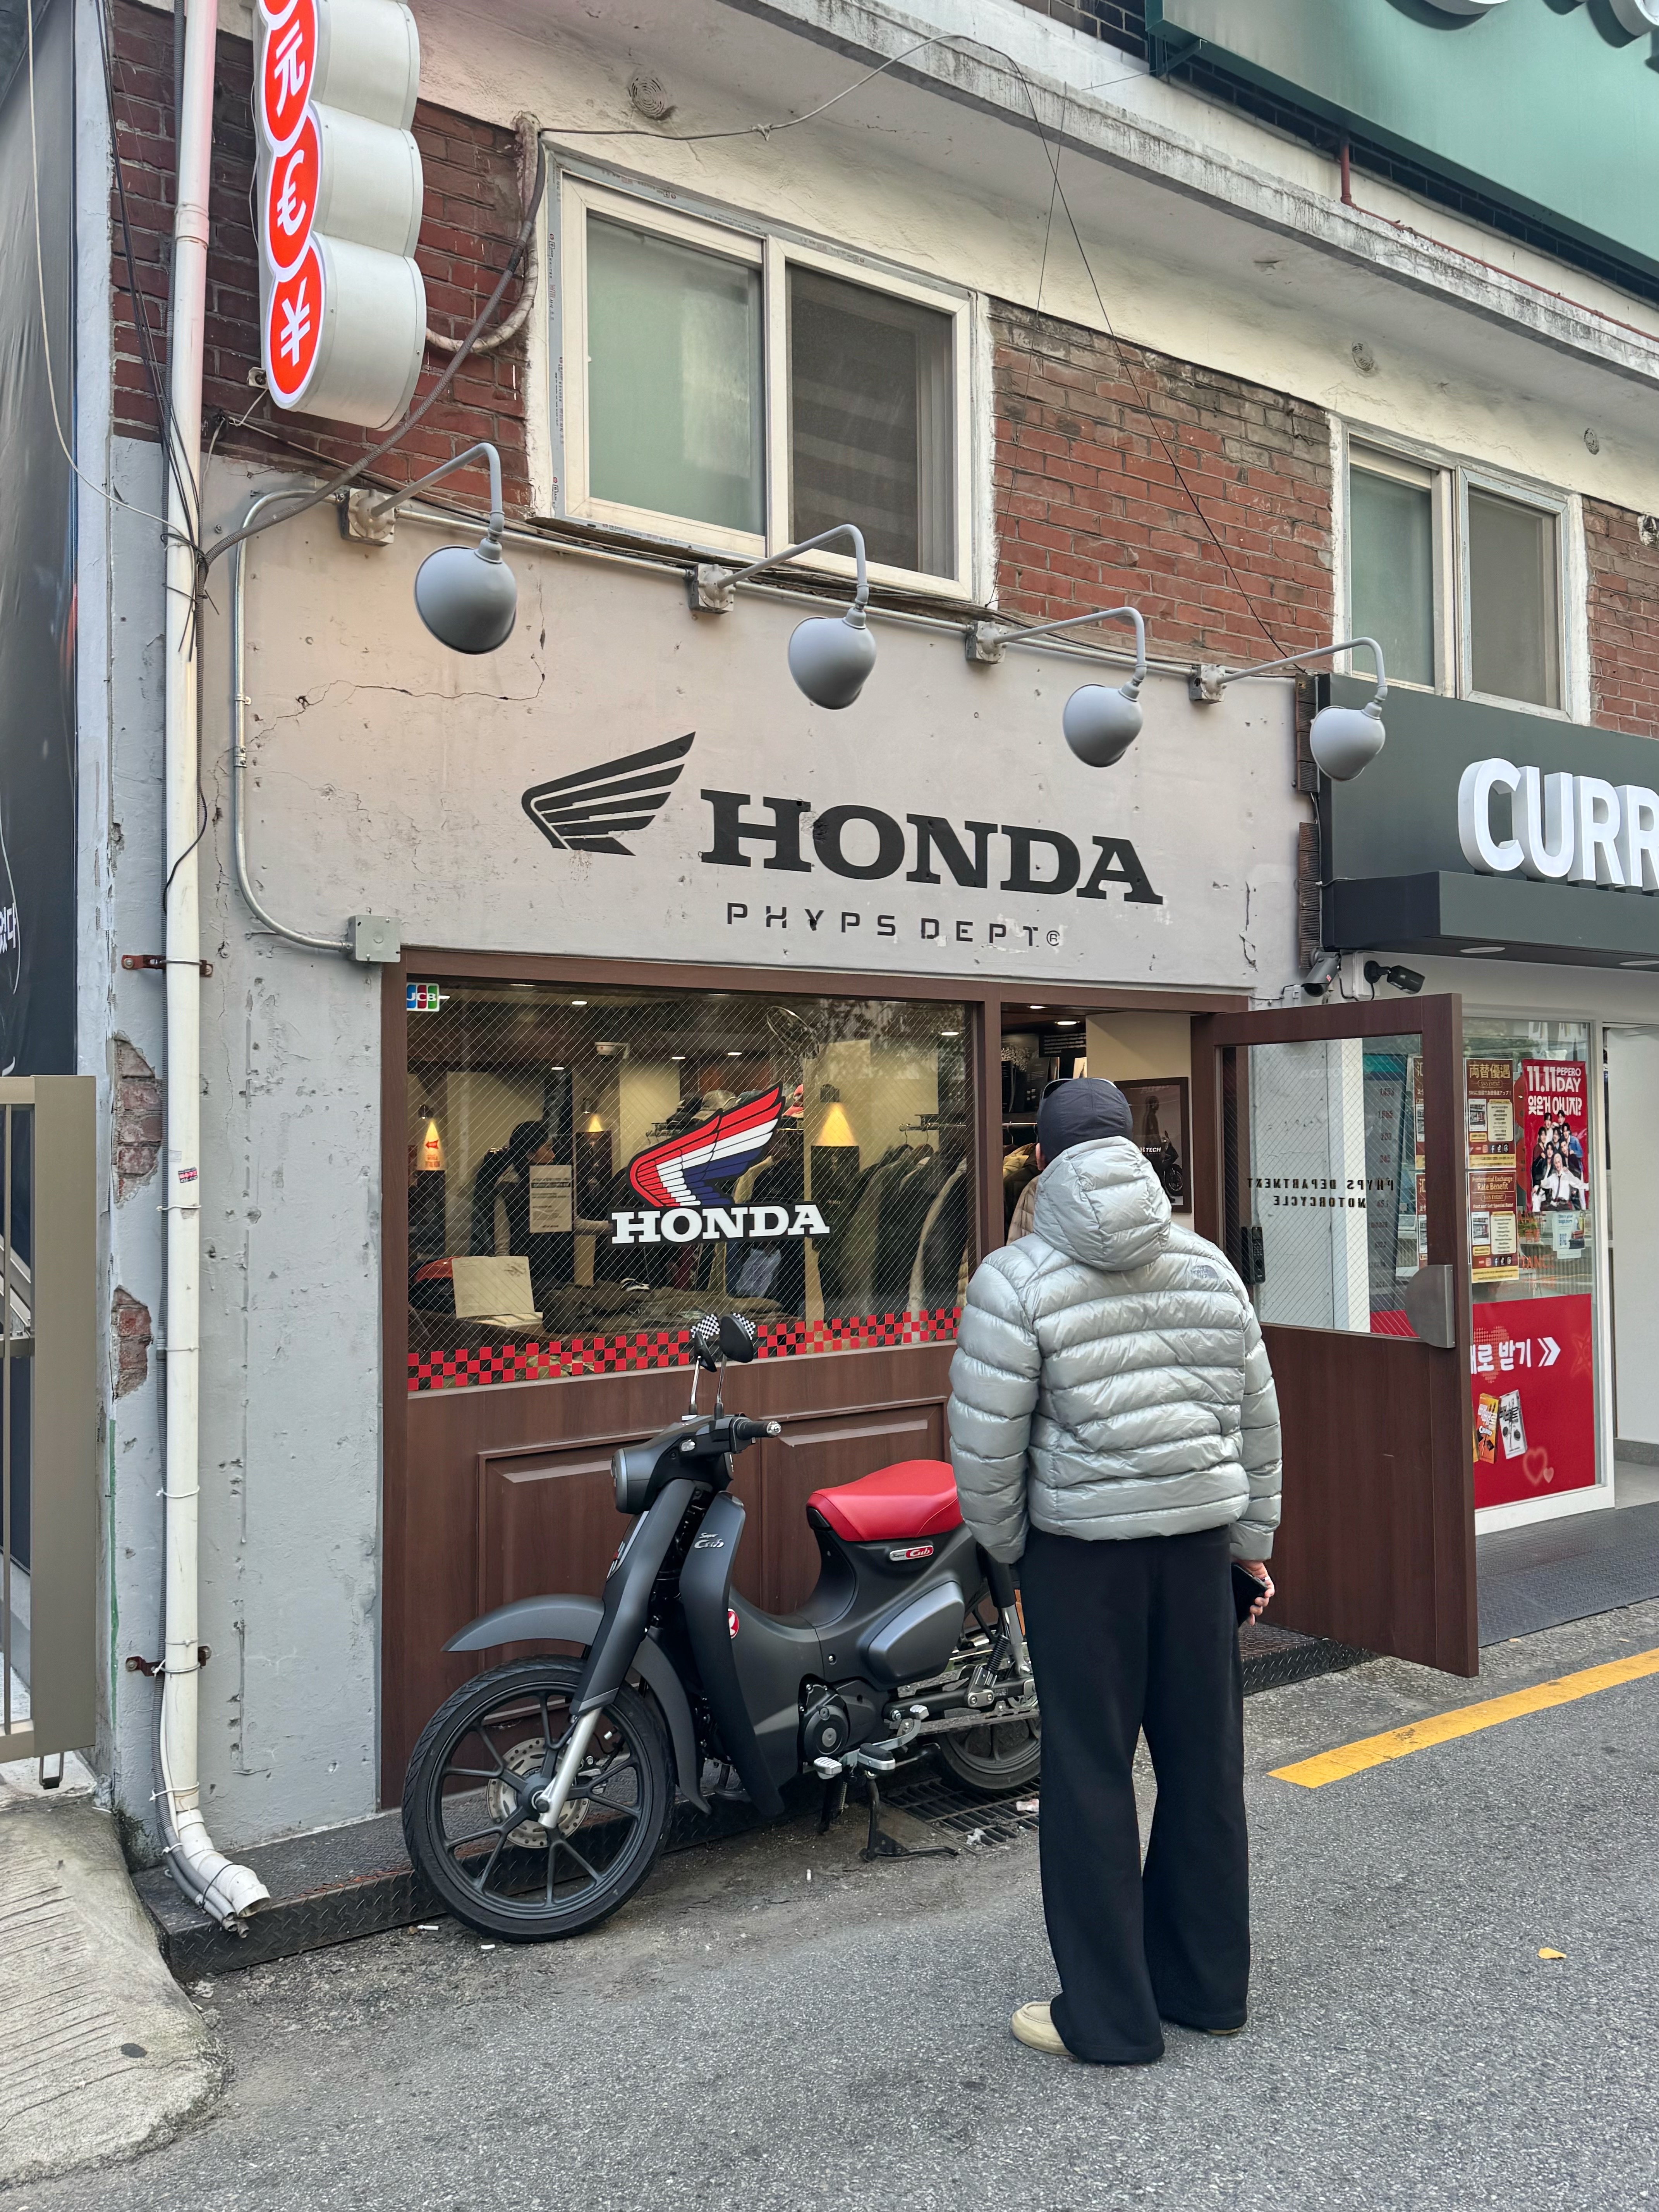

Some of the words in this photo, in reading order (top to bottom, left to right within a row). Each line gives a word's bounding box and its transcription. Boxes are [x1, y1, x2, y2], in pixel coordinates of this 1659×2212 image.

[699, 788, 1163, 905] HONDA
[727, 902, 895, 936] PHYPS
[406, 993, 436, 1001] JCB
[1469, 1063, 1511, 1079] 両替優遇
[1527, 1066, 1556, 1092] 11.11
[1556, 1067, 1581, 1077] PEPERO
[1557, 1077, 1581, 1093] DAY
[1552, 1096, 1582, 1116] 아니지?
[1490, 1182, 1508, 1190] Benefit
[611, 1204, 830, 1244] HONDA
[1498, 1338, 1531, 1371] 받기
[910, 1547, 930, 1557] Cub
